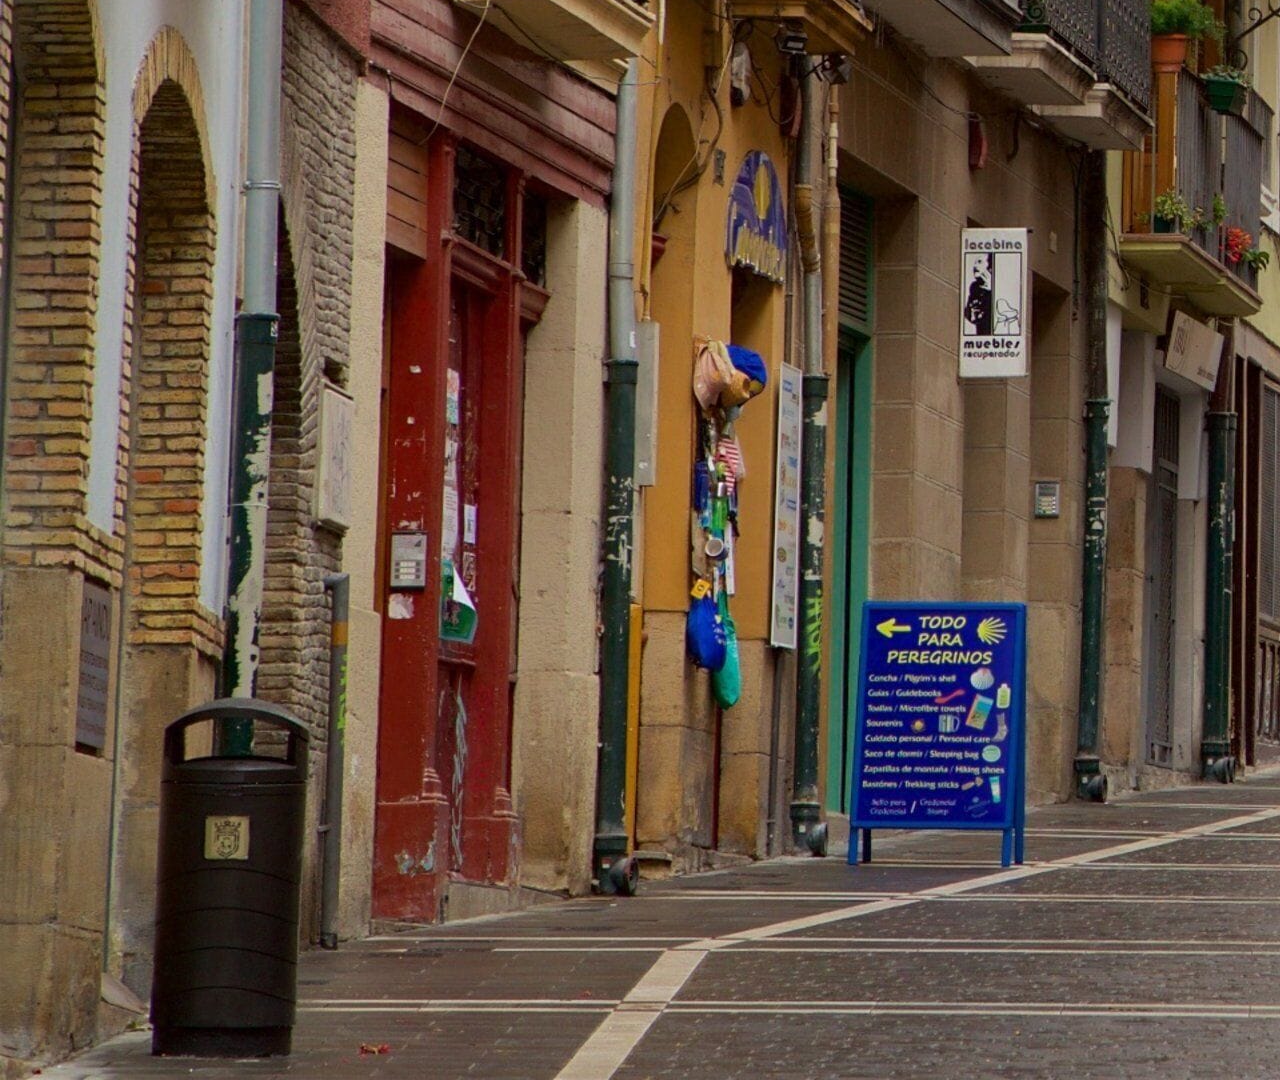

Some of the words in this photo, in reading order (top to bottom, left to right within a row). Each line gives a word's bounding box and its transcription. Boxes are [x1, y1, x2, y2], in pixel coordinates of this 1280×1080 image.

[964, 238, 1022, 250] lacabina
[963, 338, 1020, 349] muebles
[963, 350, 1020, 360] recuperados
[919, 616, 966, 629] TODO
[918, 633, 963, 646] PARA
[887, 651, 993, 664] PEREGRINOS
[869, 674, 898, 682] Concha
[904, 674, 937, 684] Pilgrim's
[938, 674, 957, 682] shell
[896, 689, 941, 697] Guidebooks
[867, 704, 893, 712] Toallas
[899, 704, 938, 712] Microfibre
[941, 704, 967, 713] towels
[866, 719, 903, 728] Souvenirs
[865, 734, 897, 742] Cuidado
[898, 734, 932, 744] personal
[939, 734, 972, 743] Personal
[864, 749, 883, 758] Saco
[885, 749, 896, 758] de
[897, 749, 923, 758] dormir
[930, 750, 963, 760] Sleeping
[964, 750, 980, 760] bag
[864, 765, 900, 775] Zapatillas
[901, 765, 912, 773] de
[955, 765, 980, 775] Hiking
[981, 765, 1005, 774] shoes
[904, 780, 937, 790] Trekking
[938, 780, 959, 789] sticks
